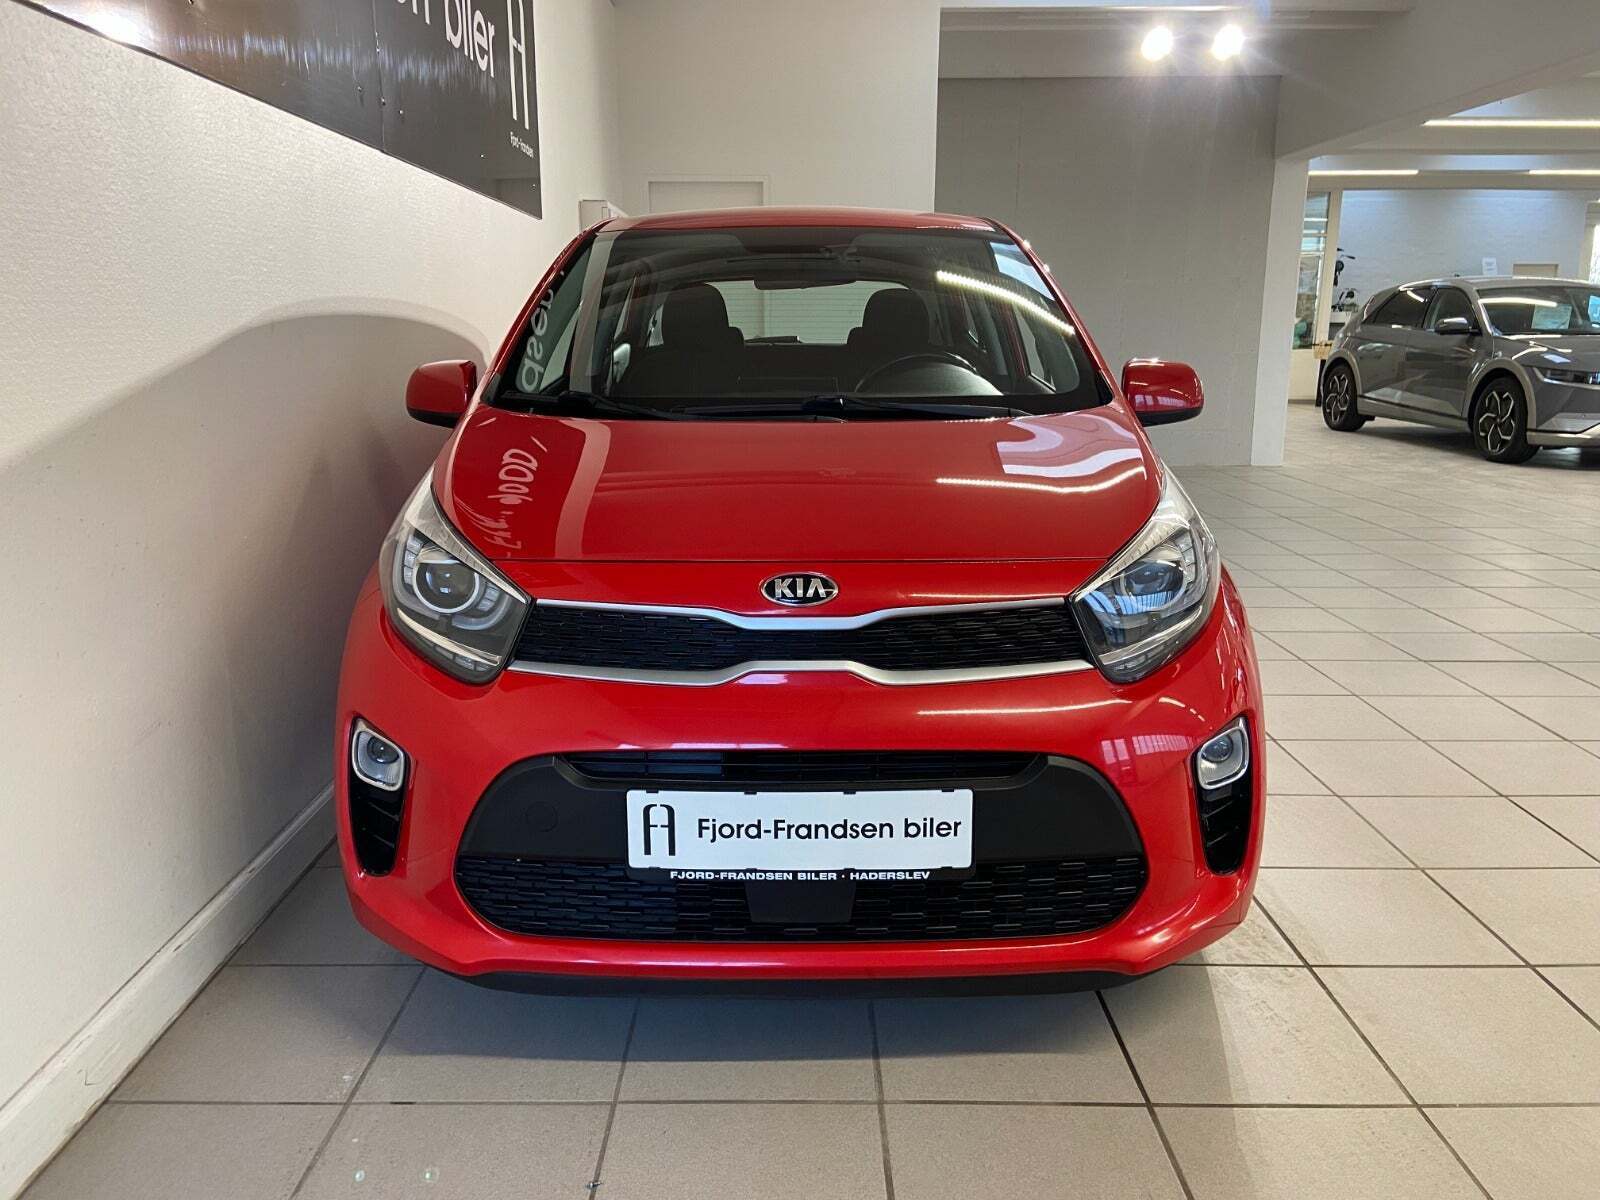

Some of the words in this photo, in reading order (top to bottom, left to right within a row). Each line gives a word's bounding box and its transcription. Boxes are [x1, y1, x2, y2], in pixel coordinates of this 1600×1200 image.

[773, 577, 828, 598] KIA
[697, 817, 895, 844] Fjord-Frandsen
[904, 816, 963, 839] biler
[669, 870, 793, 881] FJORD-FRANDSEN
[797, 871, 838, 881] BILER
[849, 870, 931, 881] HADERSLEV
